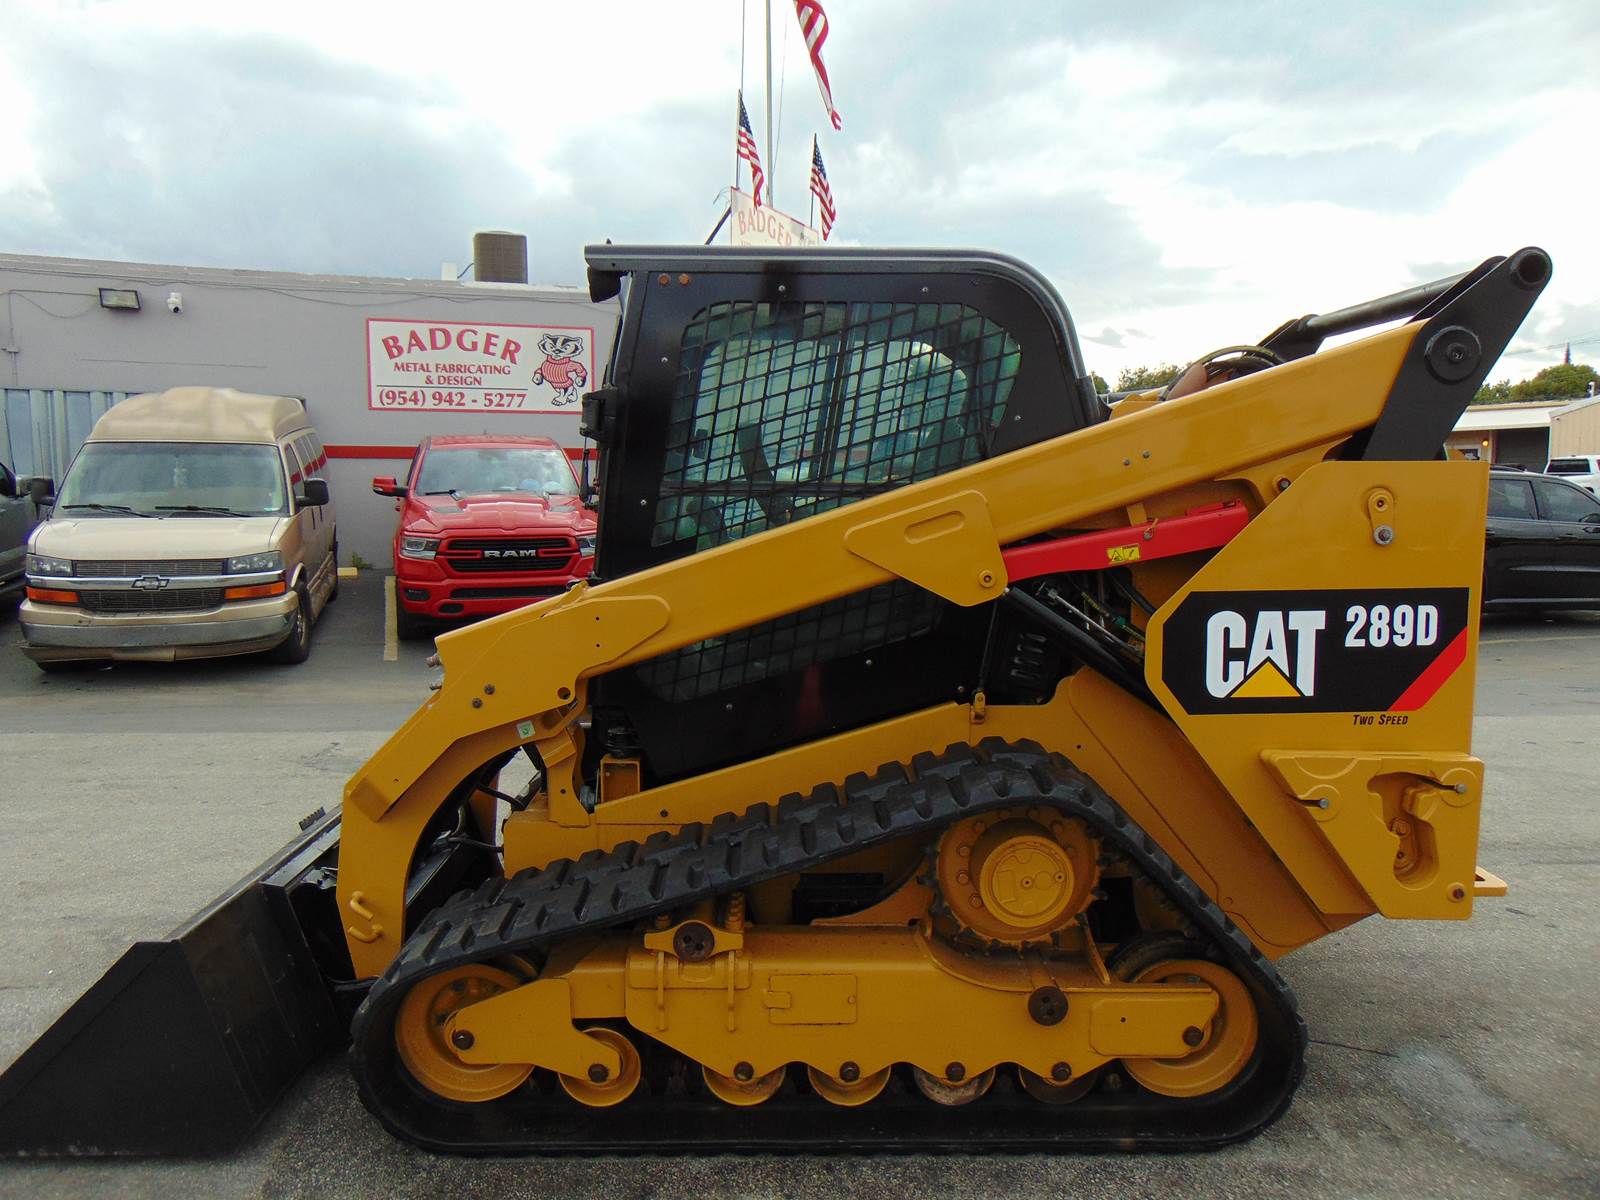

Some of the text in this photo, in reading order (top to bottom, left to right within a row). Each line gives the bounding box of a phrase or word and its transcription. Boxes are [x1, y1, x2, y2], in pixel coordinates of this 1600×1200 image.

[382, 328, 522, 365] BADGER
[394, 362, 511, 375] METAL FABRICATING
[425, 375, 482, 386] & DESIGN
[379, 389, 425, 407] (954)
[432, 392, 465, 407] 942
[484, 392, 527, 408] 5277
[484, 549, 536, 558] RAM
[1345, 605, 1439, 648] 289D
[1205, 610, 1326, 699] CAT
